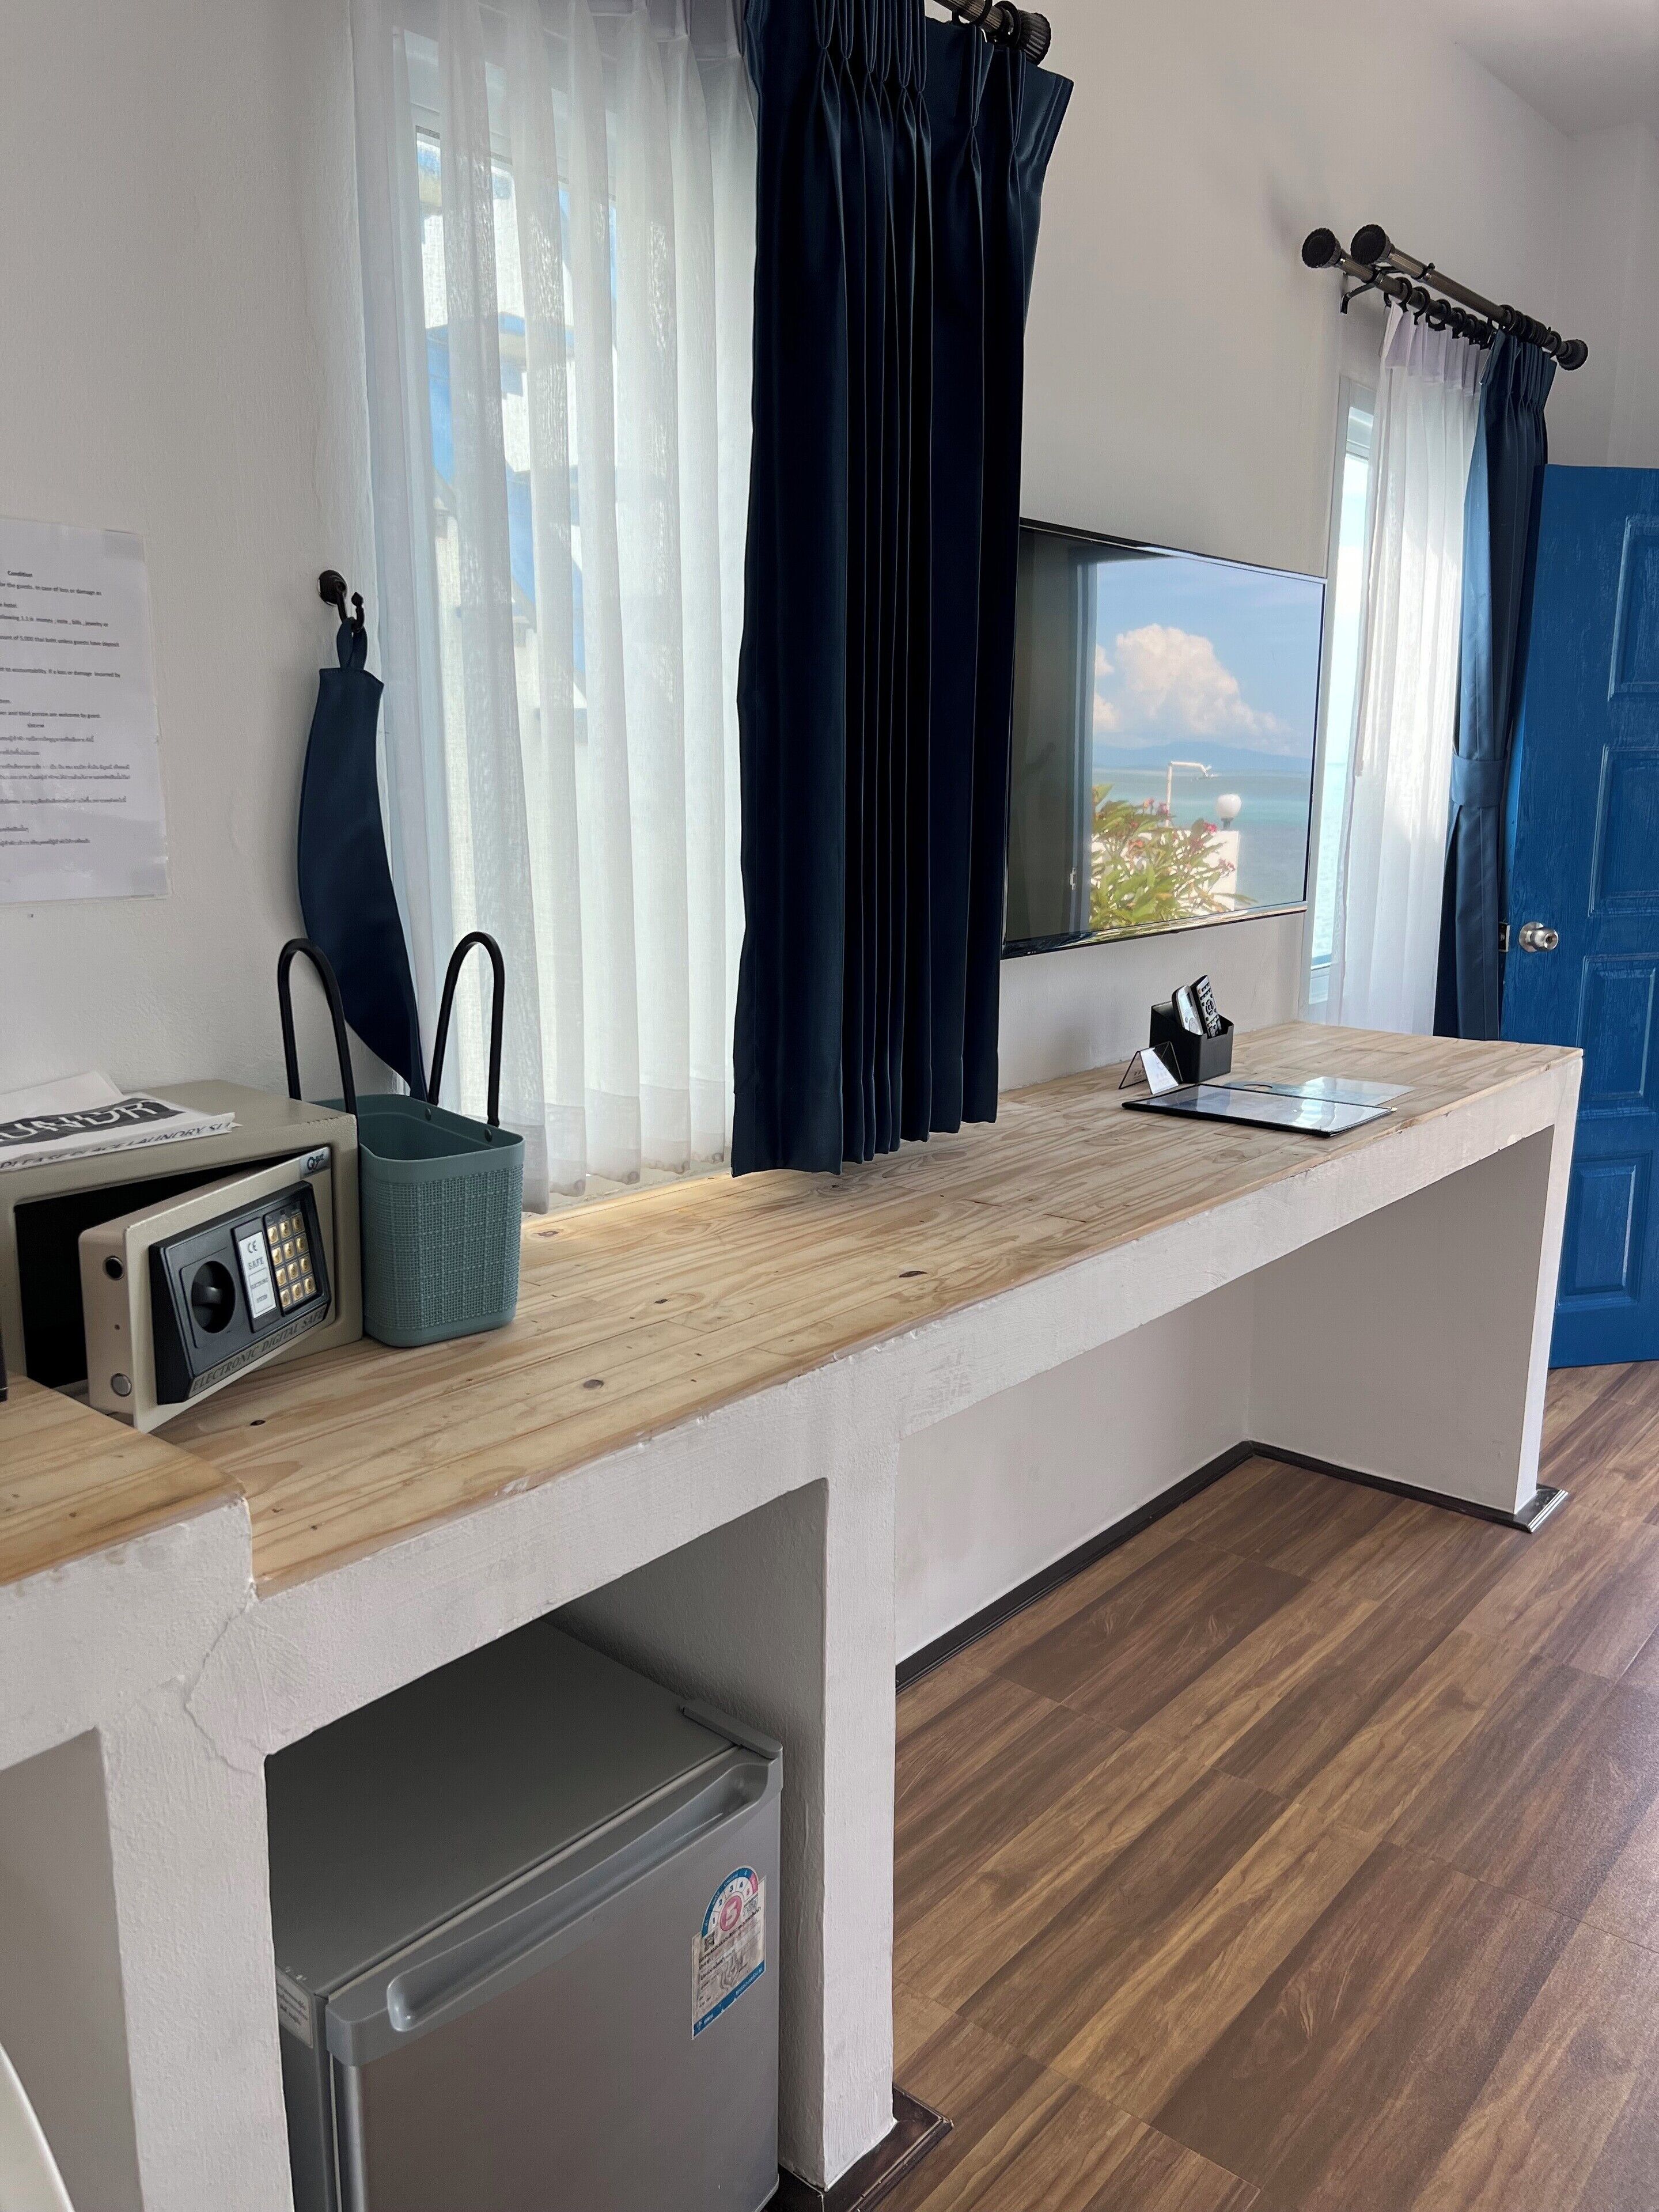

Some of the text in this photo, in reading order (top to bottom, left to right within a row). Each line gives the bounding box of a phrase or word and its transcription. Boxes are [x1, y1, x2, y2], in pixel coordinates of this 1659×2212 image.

[248, 1256, 264, 1270] SAFE
[192, 1308, 327, 1392] ELECTRONIC DIGITAL SAFE
[725, 1900, 738, 1927] 5
